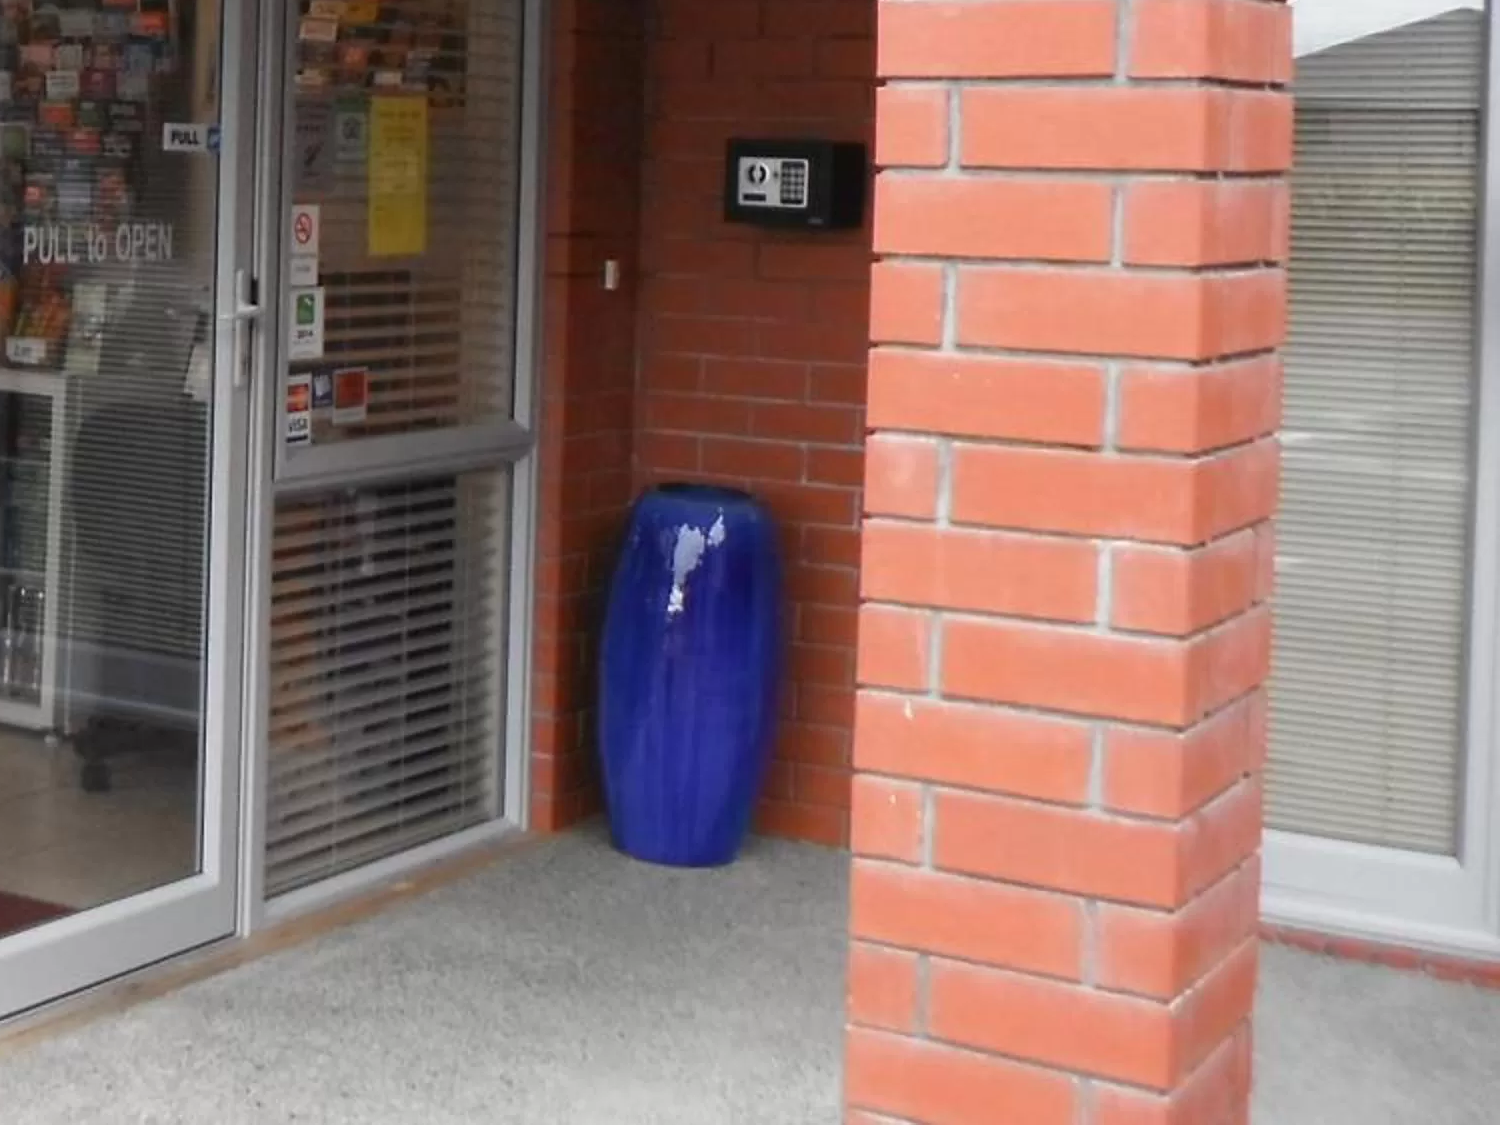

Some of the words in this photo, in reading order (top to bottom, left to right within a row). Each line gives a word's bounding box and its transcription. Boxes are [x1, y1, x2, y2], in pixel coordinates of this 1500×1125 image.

[170, 131, 200, 146] PULL
[23, 225, 80, 264] PULL
[86, 225, 107, 263] to
[115, 222, 173, 260] OPEN
